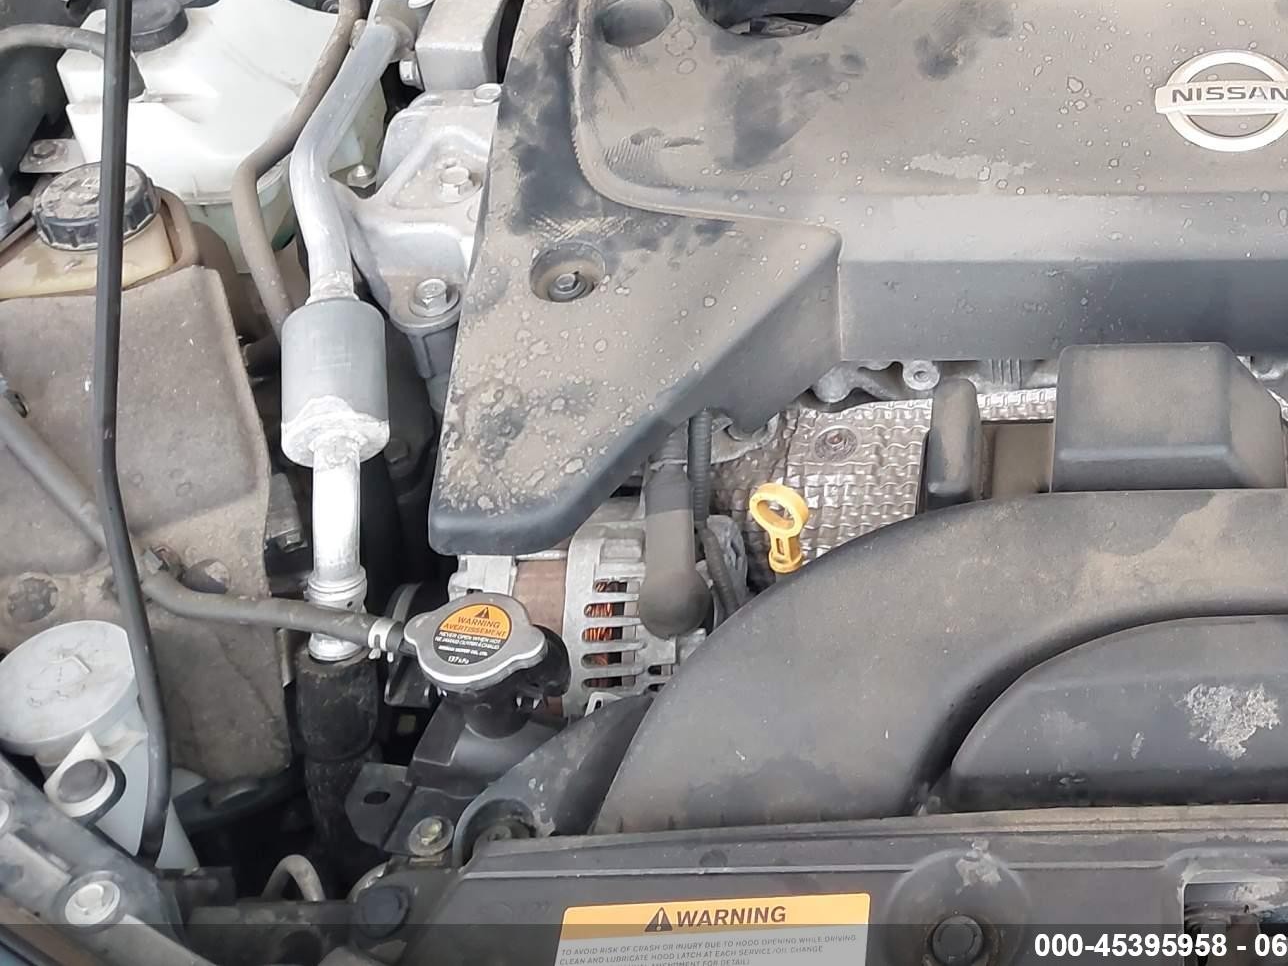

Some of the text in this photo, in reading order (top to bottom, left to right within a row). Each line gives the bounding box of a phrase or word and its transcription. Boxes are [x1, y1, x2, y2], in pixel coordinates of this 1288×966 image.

[443, 624, 507, 637] AVERTISSEMENT
[458, 617, 501, 628] WARNING
[676, 905, 787, 928] WARNING
[559, 958, 585, 966] CLEAN
[587, 956, 605, 964] AND
[606, 954, 649, 963] LUBRICATE
[651, 952, 675, 961] HOOD
[677, 951, 702, 960] LATCH
[703, 950, 713, 958] AT
[715, 949, 737, 957] EACH
[790, 945, 823, 953] CHANGE
[562, 948, 573, 956] TO
[600, 946, 619, 954] RISK
[632, 944, 659, 952] CRASH
[662, 943, 673, 951] OR
[675, 941, 702, 950] INJURY
[704, 941, 721, 949] DUE
[724, 940, 734, 948] TO
[736, 939, 759, 947] HOOD
[761, 937, 797, 946] OPENING
[799, 936, 822, 944] WHILE
[824, 934, 857, 943] DRIVING
